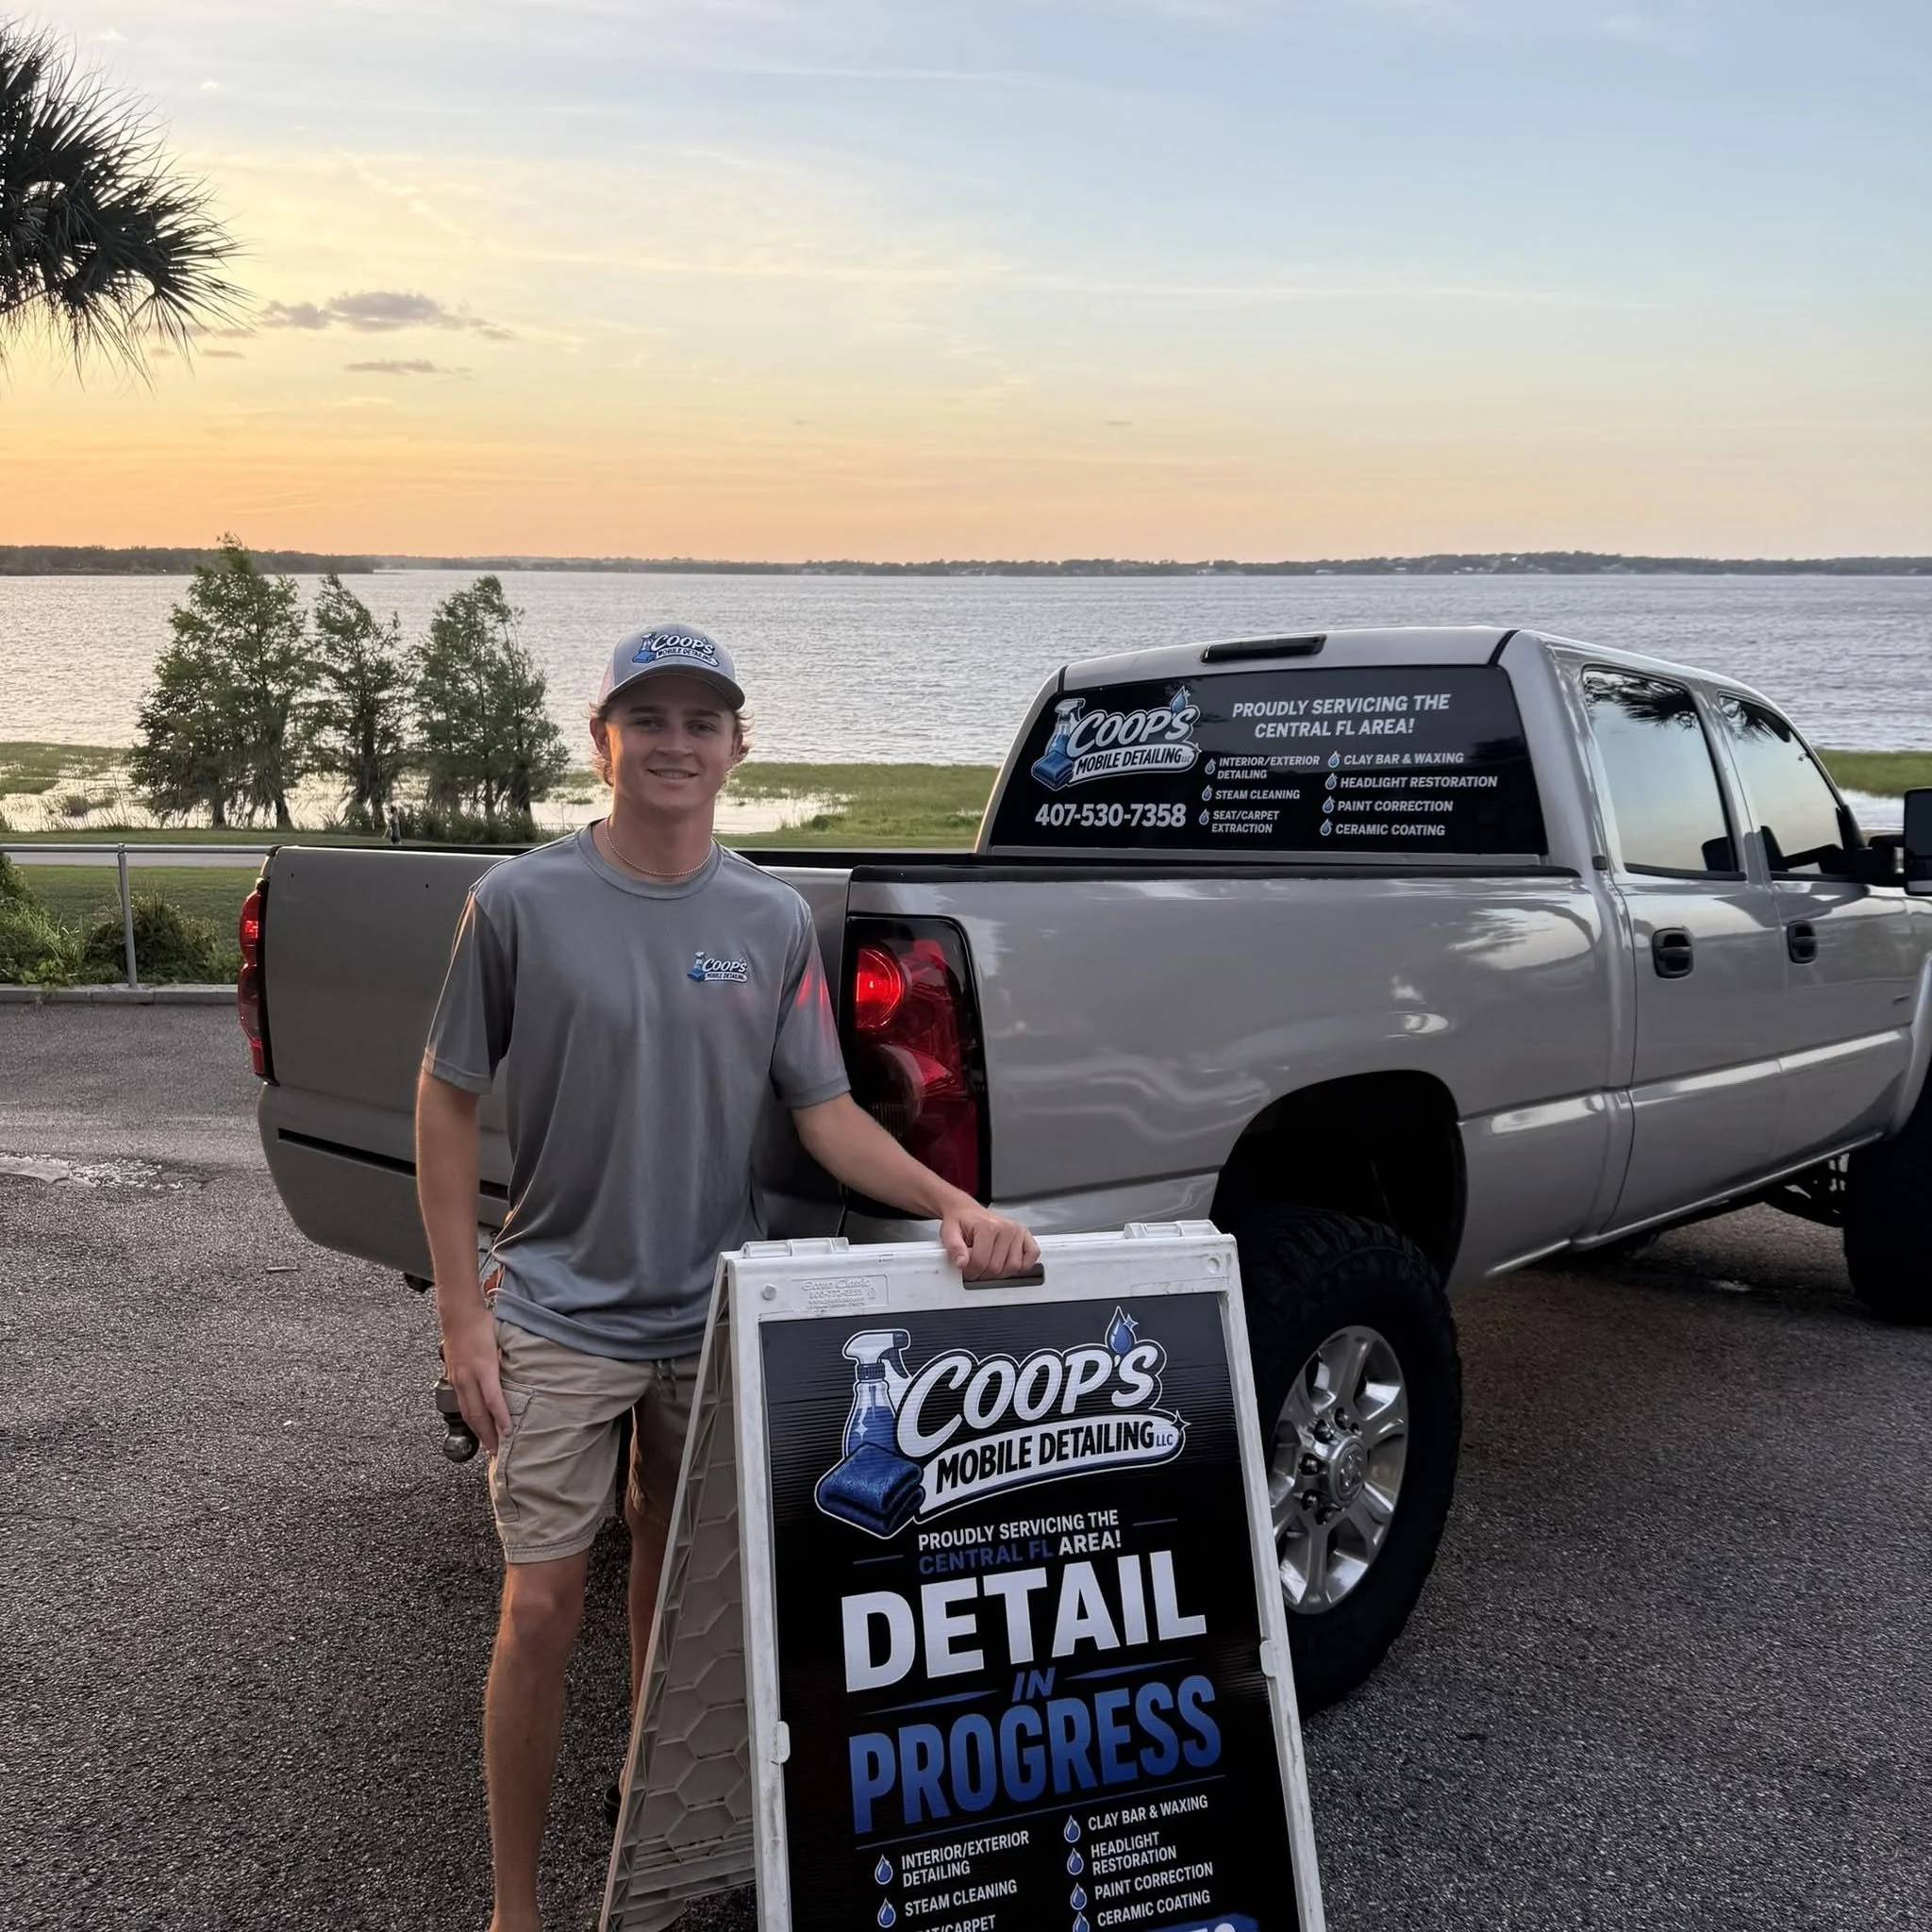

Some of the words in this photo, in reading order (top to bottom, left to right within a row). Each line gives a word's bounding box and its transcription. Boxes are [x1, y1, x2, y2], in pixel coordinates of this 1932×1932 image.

[1233, 700, 1309, 718] PROUDLY
[1312, 695, 1407, 714] SERVICING
[1412, 693, 1451, 710] THE
[1255, 721, 1331, 738] CENTRAL
[1336, 720, 1356, 737] FL
[1358, 718, 1415, 735] AREA!
[1076, 752, 1120, 774] MOBILE
[1122, 747, 1183, 770] DETAILING
[1219, 756, 1320, 767] INTERIOR/EXTERIOR
[1343, 755, 1374, 766] CLAY
[1374, 754, 1400, 765] BAR
[1404, 754, 1412, 764] &
[1415, 753, 1464, 764] WAXING
[1217, 769, 1268, 780] DETAILING
[1340, 777, 1407, 789] HEADLIGHT
[1409, 776, 1498, 788] RESTORATION
[1215, 790, 1248, 800] STEAM
[1250, 790, 1301, 800] CLEANING
[1338, 801, 1372, 812] PAINT
[1374, 801, 1454, 811] CORRECTION
[1035, 803, 1187, 827] 407-530-7358
[1213, 810, 1280, 822] SEAT/CARPET
[1211, 824, 1273, 834] EXTRACTION
[1335, 824, 1390, 835] CERAMIC
[1391, 824, 1446, 836] COATING
[897, 1343, 1159, 1457] COOP'S
[937, 1434, 1033, 1494] MOBILE
[1039, 1421, 1155, 1466] DETAILING
[1156, 1433, 1174, 1448] LLC
[918, 1524, 995, 1552] PROUDLY
[999, 1515, 1086, 1541] SERVICING
[1088, 1509, 1119, 1528] THE
[919, 1547, 1024, 1575] CENTRAL
[1029, 1541, 1054, 1561] FL
[1058, 1530, 1122, 1557] AREA!
[841, 1550, 1207, 1693] DETAIL
[1012, 1667, 1056, 1702] IN
[849, 1674, 1222, 1835] PROGRESS
[1088, 1812, 1119, 1831] CLAY
[1122, 1807, 1147, 1825] BAR
[1149, 1806, 1158, 1819] &
[1160, 1794, 1208, 1817] WAXING
[901, 1830, 1030, 1871] INTERIOR/EXTERIOR
[1091, 1831, 1159, 1858] HEADLIGHT
[903, 1860, 971, 1888] DETAILING
[1092, 1845, 1177, 1876] RESTORATION
[1094, 1879, 1131, 1901] PAINT
[1134, 1861, 1214, 1891] CORRECTION
[905, 1896, 950, 1917] STEAM
[953, 1879, 1018, 1907] CLEANING
[1097, 1900, 1155, 1927] CERAMIC
[1157, 1890, 1211, 1914] COATING
[916, 1914, 996, 1932] CARPET
